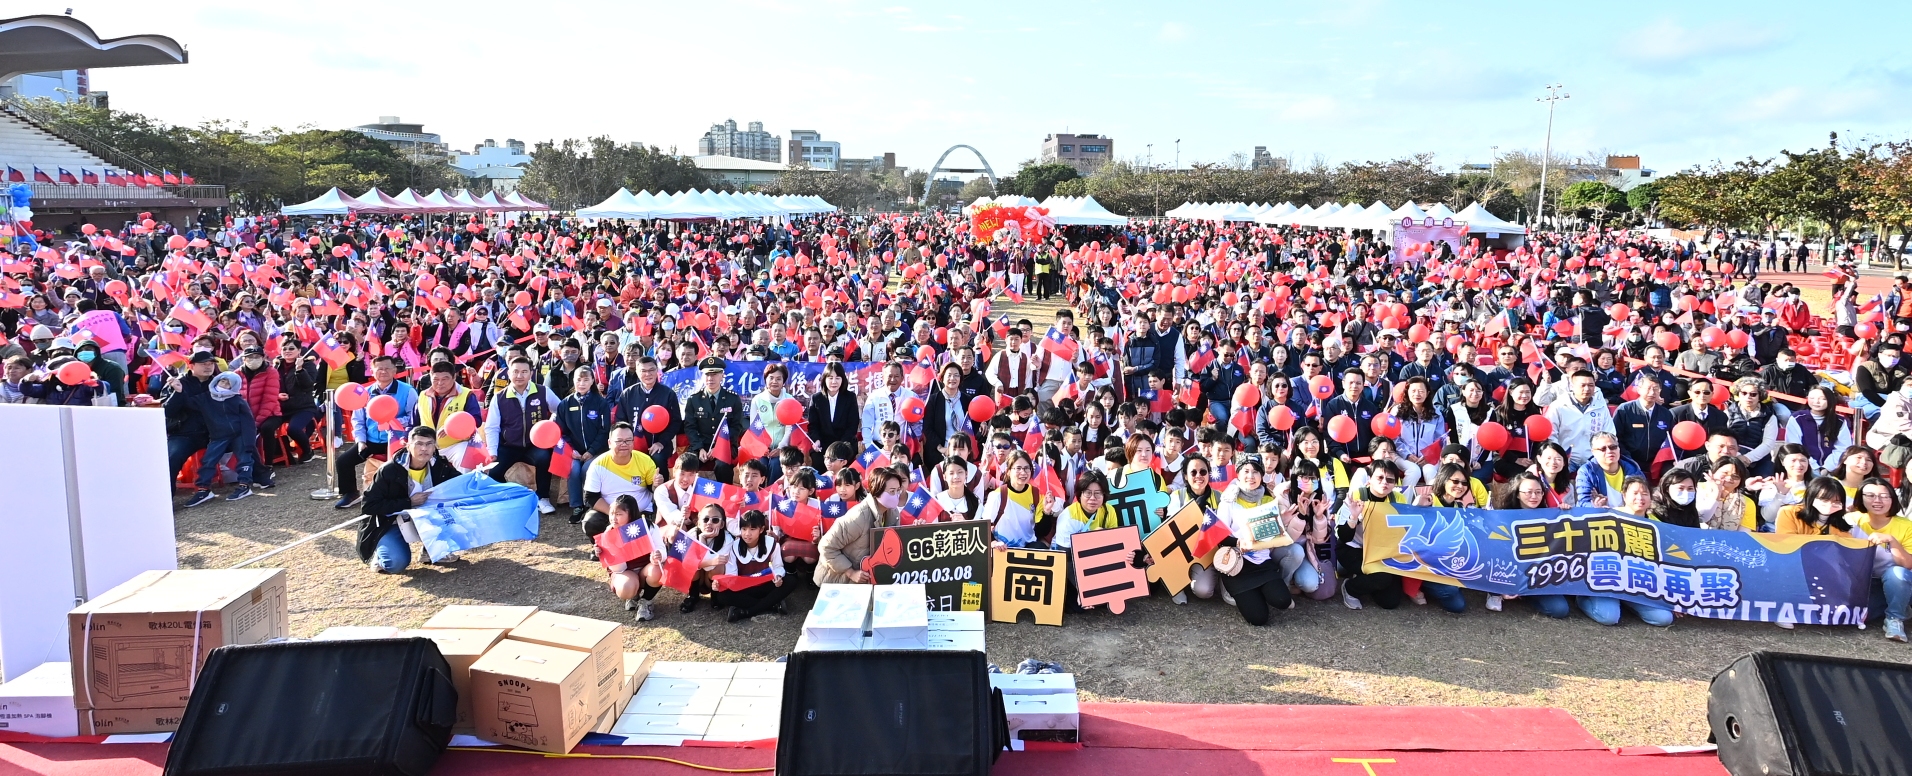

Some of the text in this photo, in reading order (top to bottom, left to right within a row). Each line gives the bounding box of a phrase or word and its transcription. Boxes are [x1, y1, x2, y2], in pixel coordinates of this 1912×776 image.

[908, 528, 987, 561] 96彰商人
[1161, 520, 1209, 564] 十
[1516, 518, 1656, 561] 三十而麗
[892, 565, 973, 585] 2026.03.08
[1004, 551, 1055, 606] 崗
[1077, 542, 1135, 599] 三
[1450, 556, 1465, 571] 96
[1526, 554, 1739, 606] 1996 雲崗再聚
[498, 679, 531, 692] SNOOPY
[94, 717, 114, 727] olin
[1833, 710, 1847, 726] RCF
